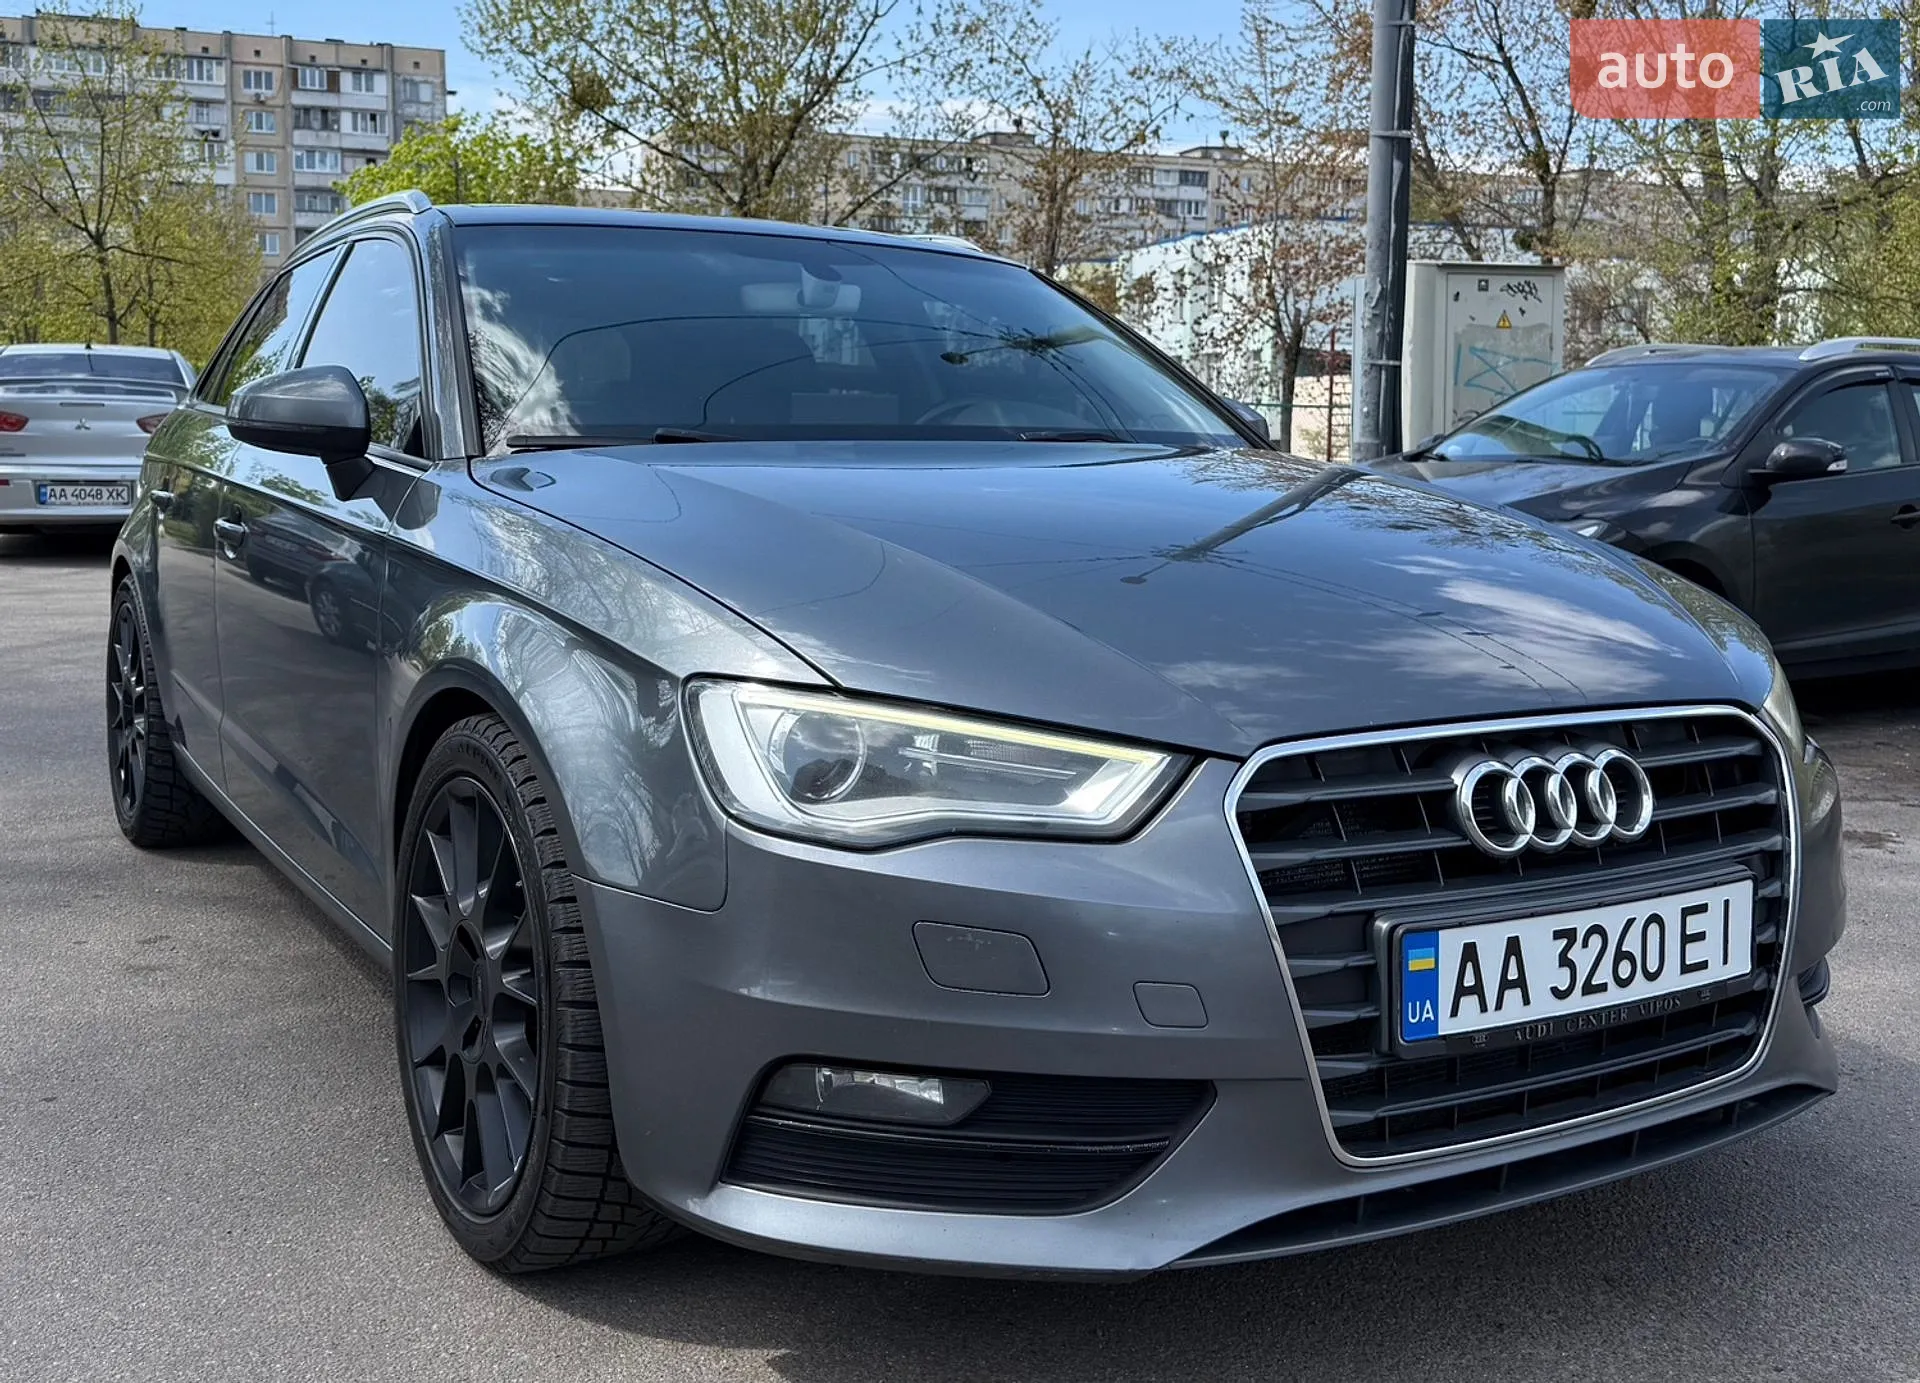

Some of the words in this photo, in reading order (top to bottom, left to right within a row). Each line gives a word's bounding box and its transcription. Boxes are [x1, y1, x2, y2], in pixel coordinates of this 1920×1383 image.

[47, 487, 68, 501] AA
[70, 487, 104, 501] 4048
[106, 487, 127, 501] XK
[1449, 935, 1531, 1019] AA
[1549, 912, 1666, 1001] 3260
[1678, 898, 1730, 976] EI
[1407, 1000, 1435, 1024] UA
[1514, 1022, 1554, 1041] AUDI
[1565, 1009, 1629, 1033] CENTER
[1638, 995, 1682, 1017] VIPOS
